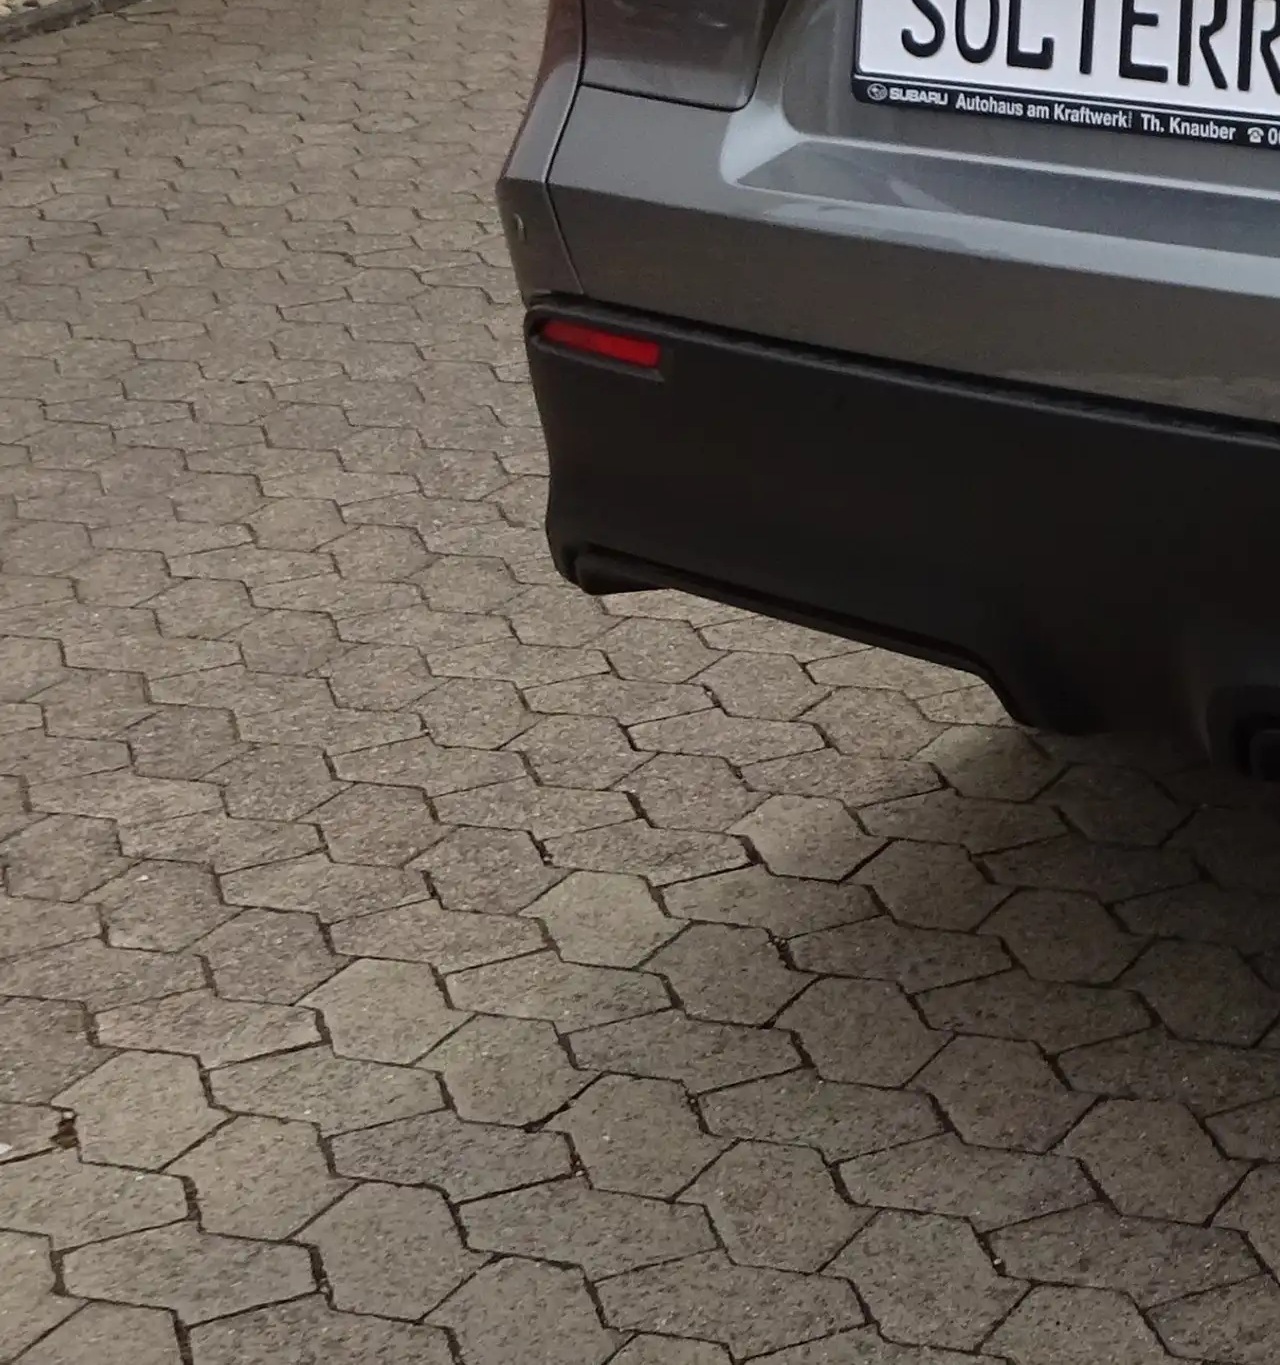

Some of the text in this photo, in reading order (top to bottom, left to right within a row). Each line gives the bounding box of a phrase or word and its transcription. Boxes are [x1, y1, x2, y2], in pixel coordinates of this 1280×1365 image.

[888, 88, 949, 105] SUBARU
[955, 92, 1024, 117] Autohaus
[1026, 102, 1050, 120] am
[1053, 104, 1128, 128] Kraftwerk
[1140, 113, 1165, 134] Th.
[1169, 117, 1237, 141] Knauber
